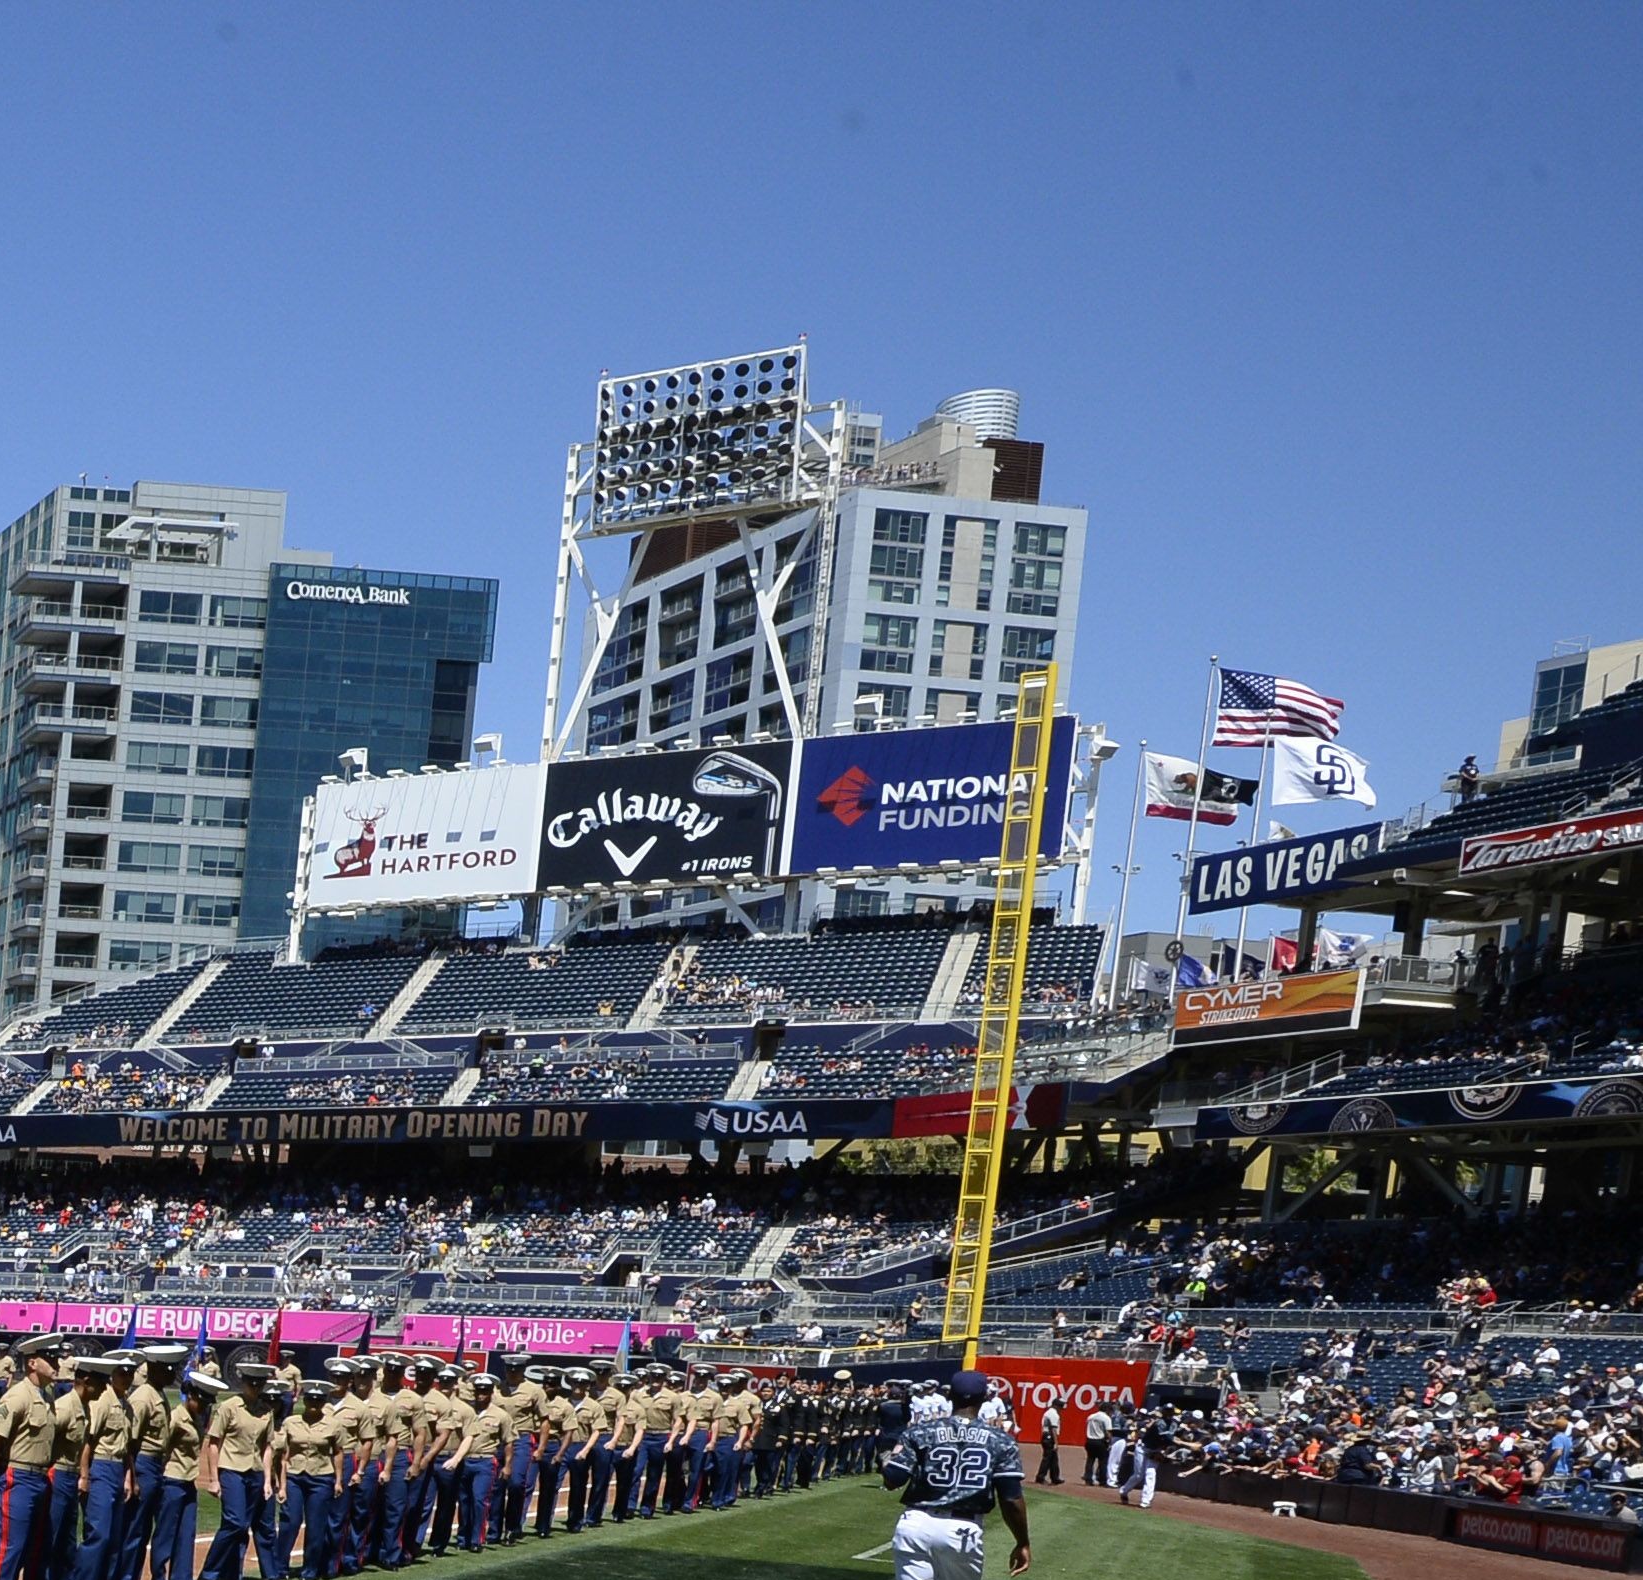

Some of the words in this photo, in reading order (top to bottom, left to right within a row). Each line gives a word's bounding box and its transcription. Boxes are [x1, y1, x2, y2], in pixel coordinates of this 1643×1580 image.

[368, 586, 411, 605] Bank
[547, 788, 720, 849] Callaway
[878, 801, 1030, 832] FUNDING
[385, 832, 429, 852] THE
[1465, 826, 1602, 870] Tarantino
[380, 848, 517, 875] HARTFORD
[681, 860, 698, 872] #1
[701, 856, 753, 871] IRONS
[1197, 856, 1254, 903] LAS
[1185, 981, 1283, 1011] CYMER
[1199, 1004, 1261, 1025] STRIKEOUTS
[733, 1110, 808, 1134] USAA
[161, 1309, 210, 1331] RUN
[1017, 1381, 1135, 1411] TOYOTA
[937, 1426, 990, 1445] BLASH
[926, 1446, 992, 1490] 32
[1461, 1512, 1532, 1545] petco.com
